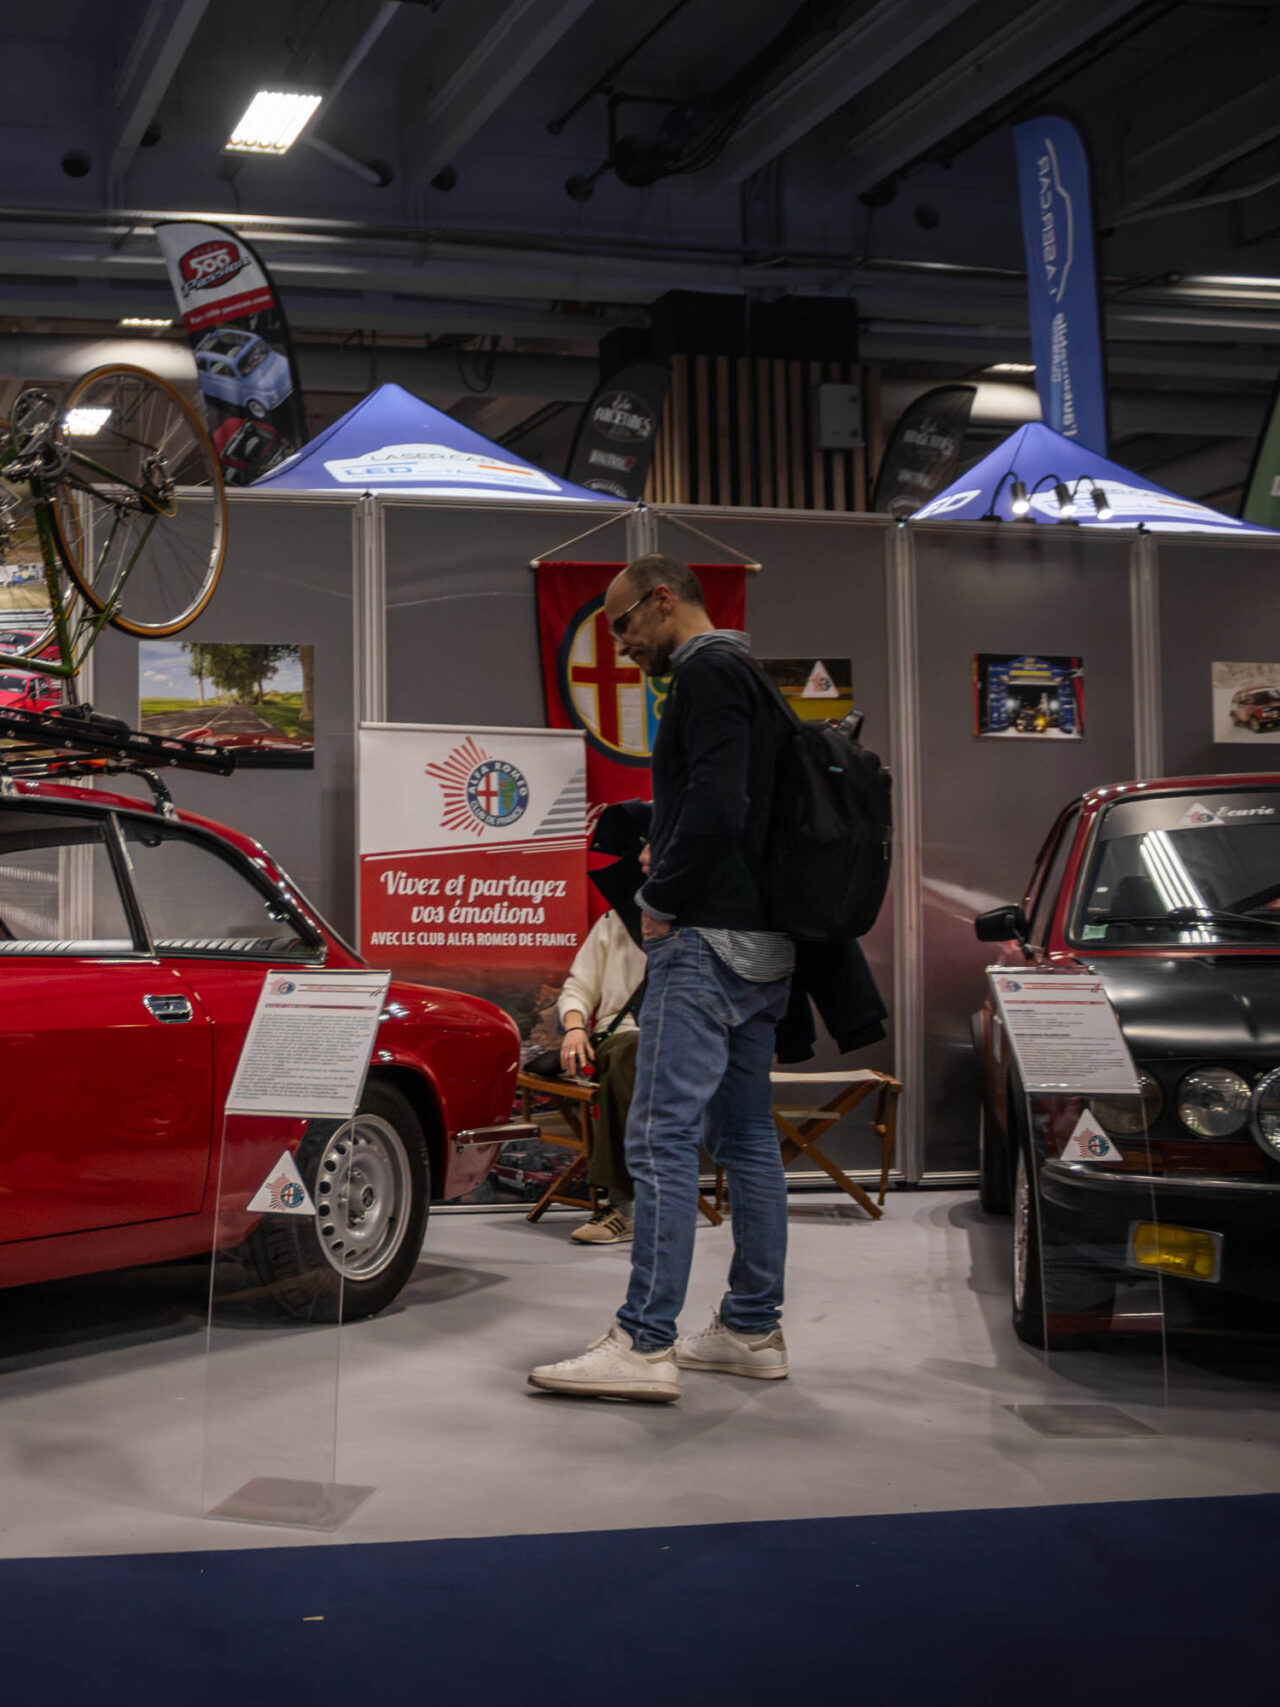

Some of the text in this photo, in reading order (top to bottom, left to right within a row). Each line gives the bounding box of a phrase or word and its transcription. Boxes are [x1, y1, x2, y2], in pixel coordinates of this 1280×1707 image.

[189, 248, 230, 280] 500
[380, 870, 566, 904] Vivez et partagez
[411, 900, 545, 924] vos émotions
[370, 931, 577, 946] AVEC LE CLUB ALFA ROMEO DE FRANCE
